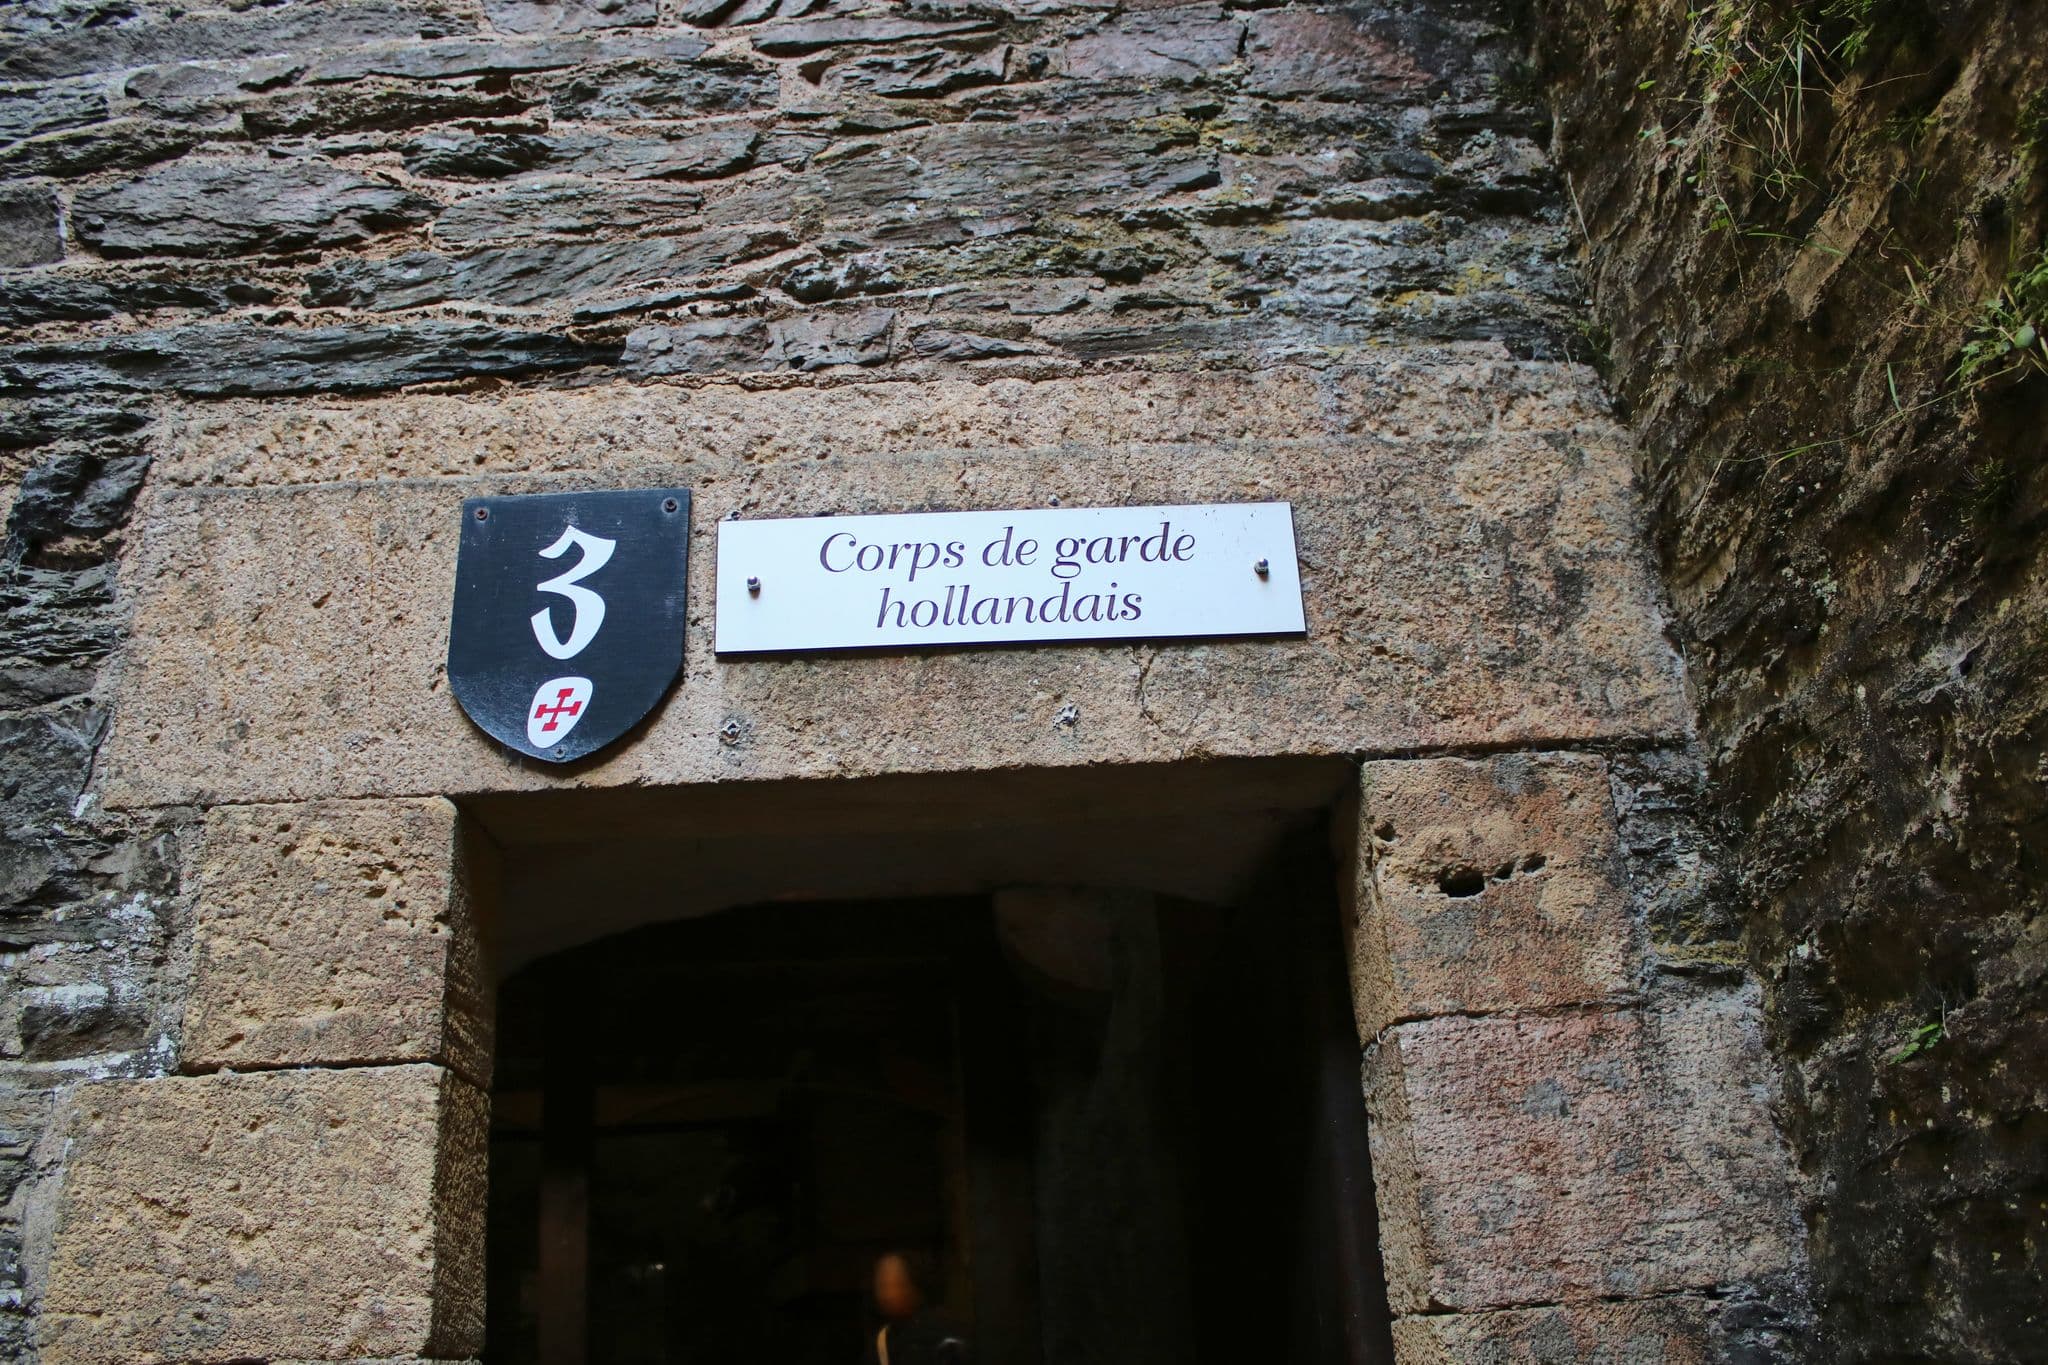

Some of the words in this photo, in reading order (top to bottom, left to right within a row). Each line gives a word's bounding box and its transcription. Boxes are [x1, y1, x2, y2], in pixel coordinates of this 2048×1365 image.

[820, 532, 964, 582] Corps
[982, 525, 1038, 566] de
[1051, 521, 1195, 578] garde
[530, 525, 616, 660] 3
[877, 582, 1142, 628] hollandais
